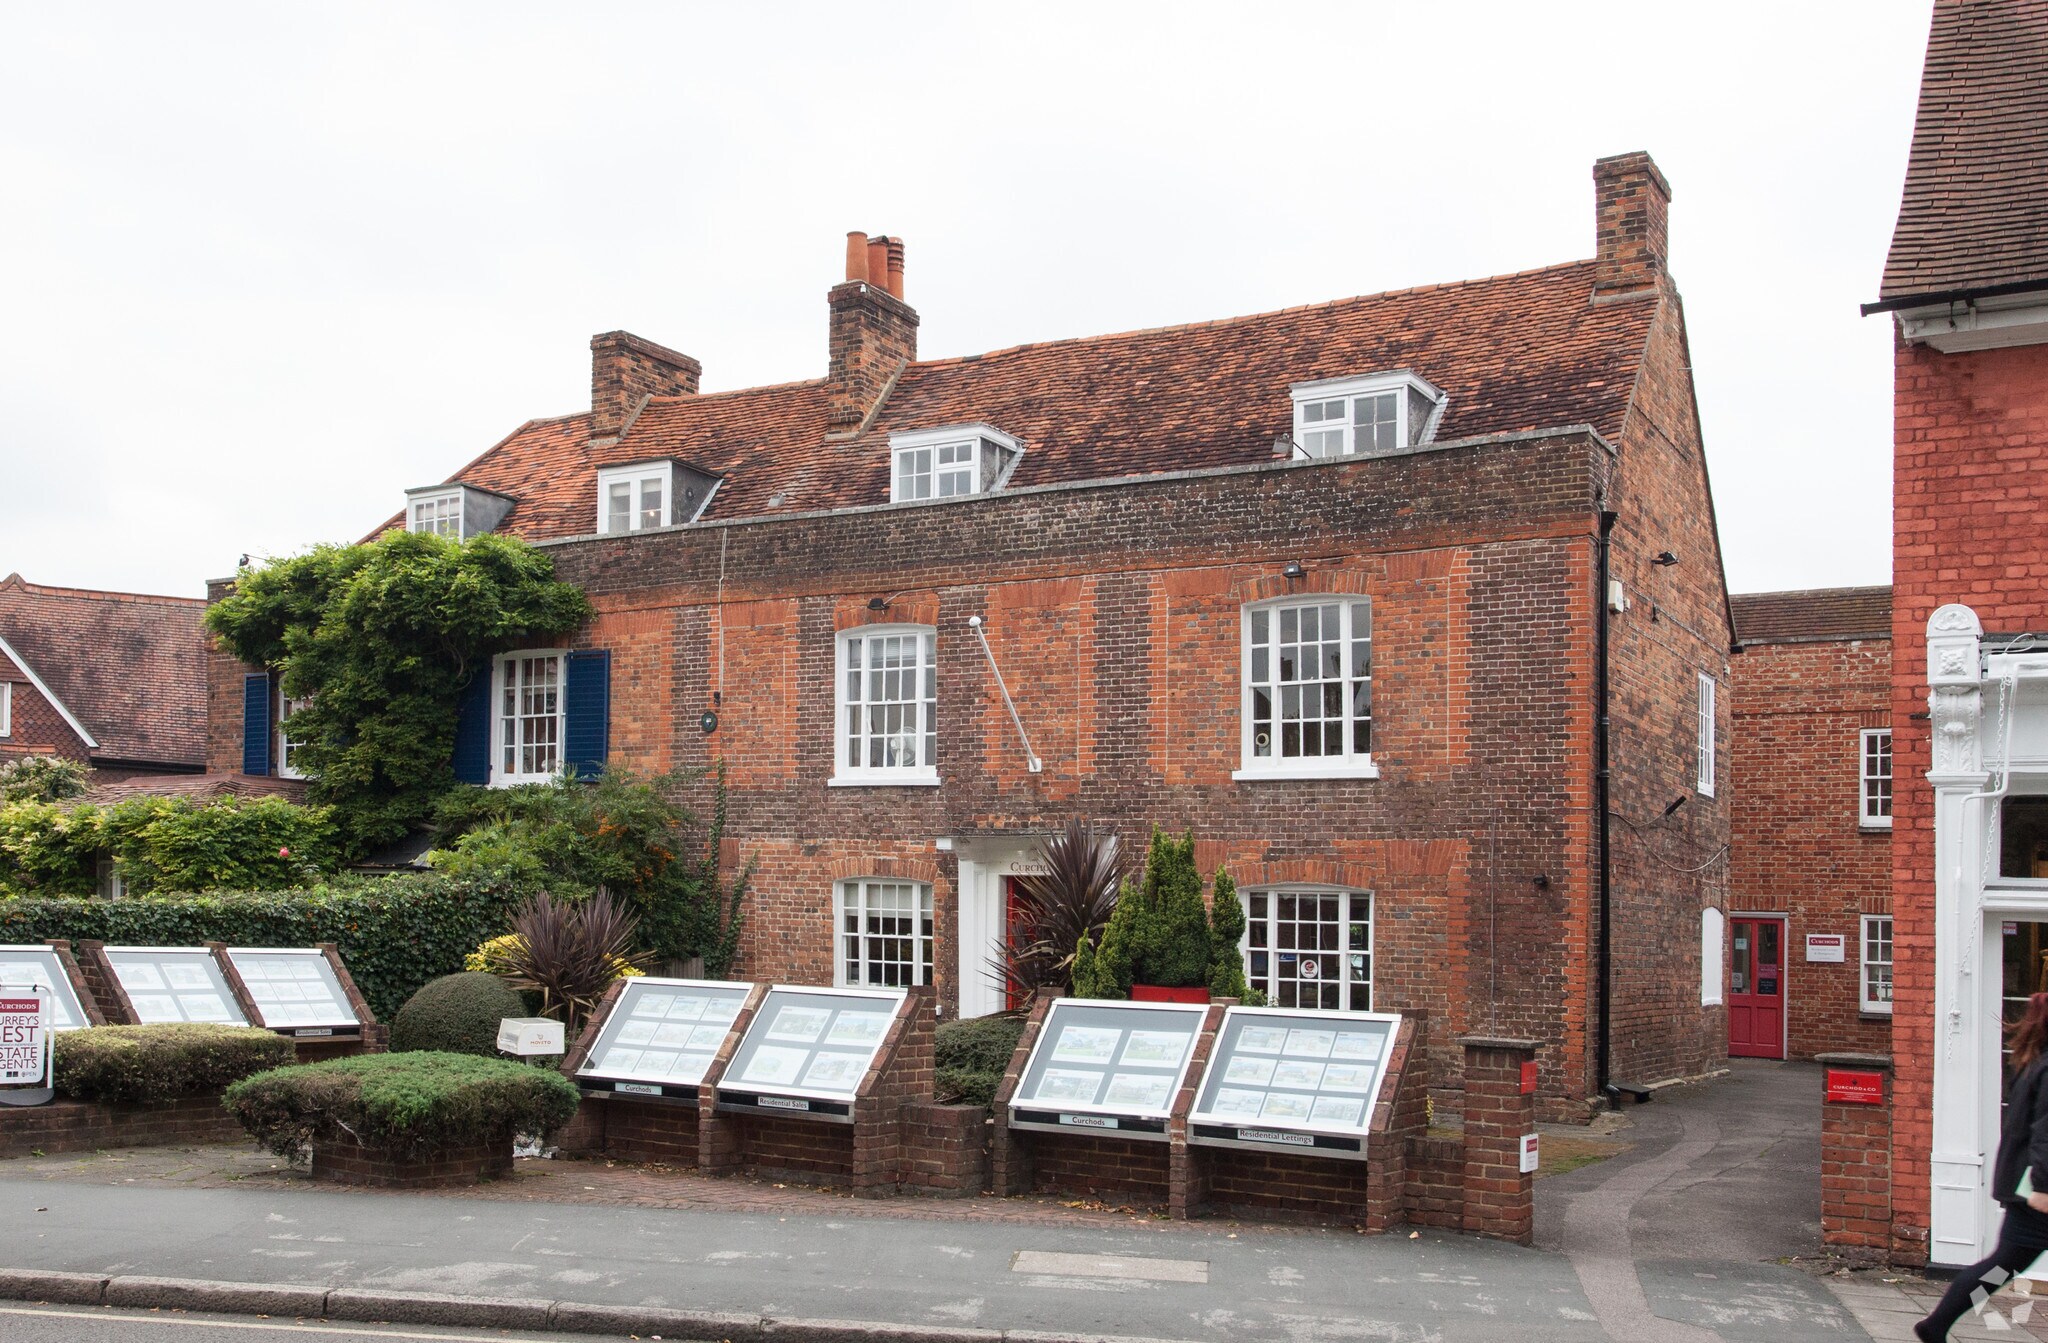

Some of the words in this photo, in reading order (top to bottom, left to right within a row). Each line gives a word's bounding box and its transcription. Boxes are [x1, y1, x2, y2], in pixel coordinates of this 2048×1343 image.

[1010, 861, 1049, 872] CURCHO
[0, 1015, 39, 1025] URREY'S
[0, 1026, 39, 1042] EST
[0, 1047, 38, 1058] STATE
[0, 1058, 37, 1069] GENTS
[625, 1084, 652, 1093] Curchods
[759, 1097, 791, 1107] Residential
[792, 1100, 808, 1109] Sales
[1072, 1115, 1105, 1126] Curchods
[1239, 1130, 1280, 1141] Residential
[1281, 1133, 1312, 1144] Lettings
